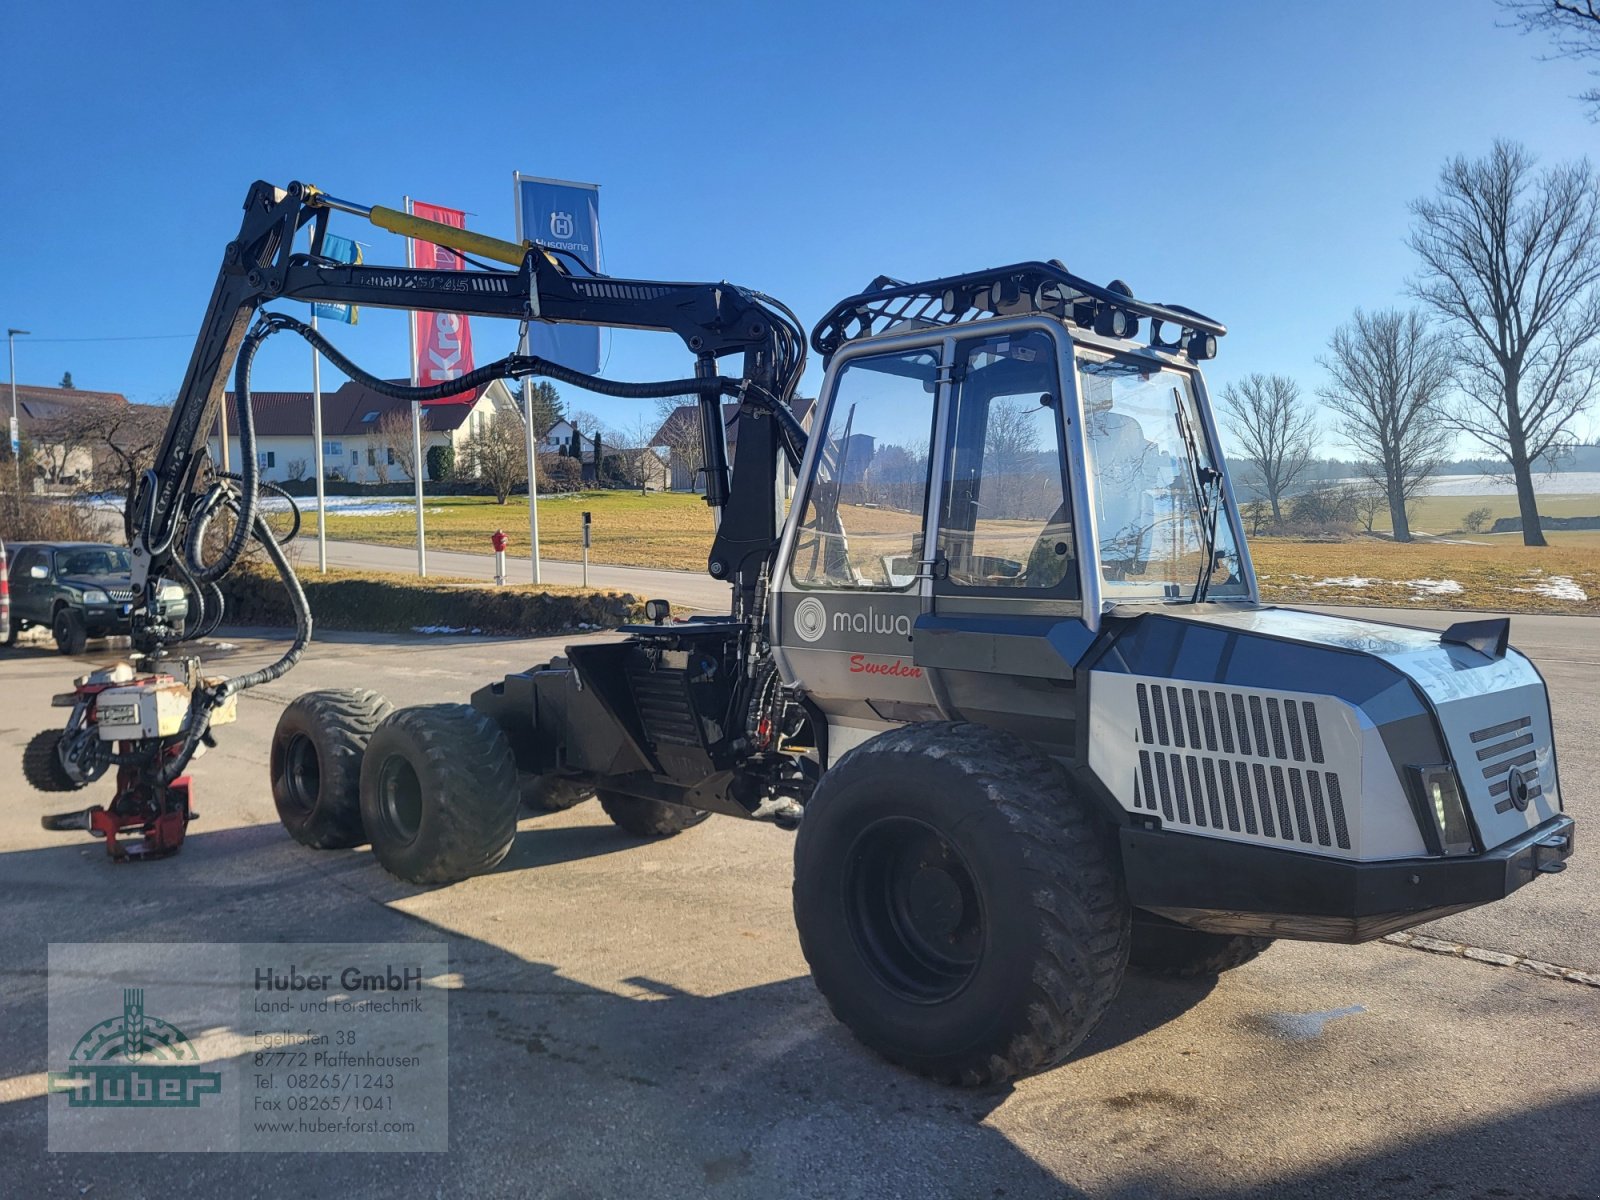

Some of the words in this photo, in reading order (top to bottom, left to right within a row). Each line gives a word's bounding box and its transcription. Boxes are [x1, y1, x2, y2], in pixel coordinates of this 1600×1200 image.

[535, 238, 589, 252] Husqvarna
[428, 312, 463, 381] Kre
[833, 606, 911, 636] malwa
[850, 653, 922, 678] Sweden
